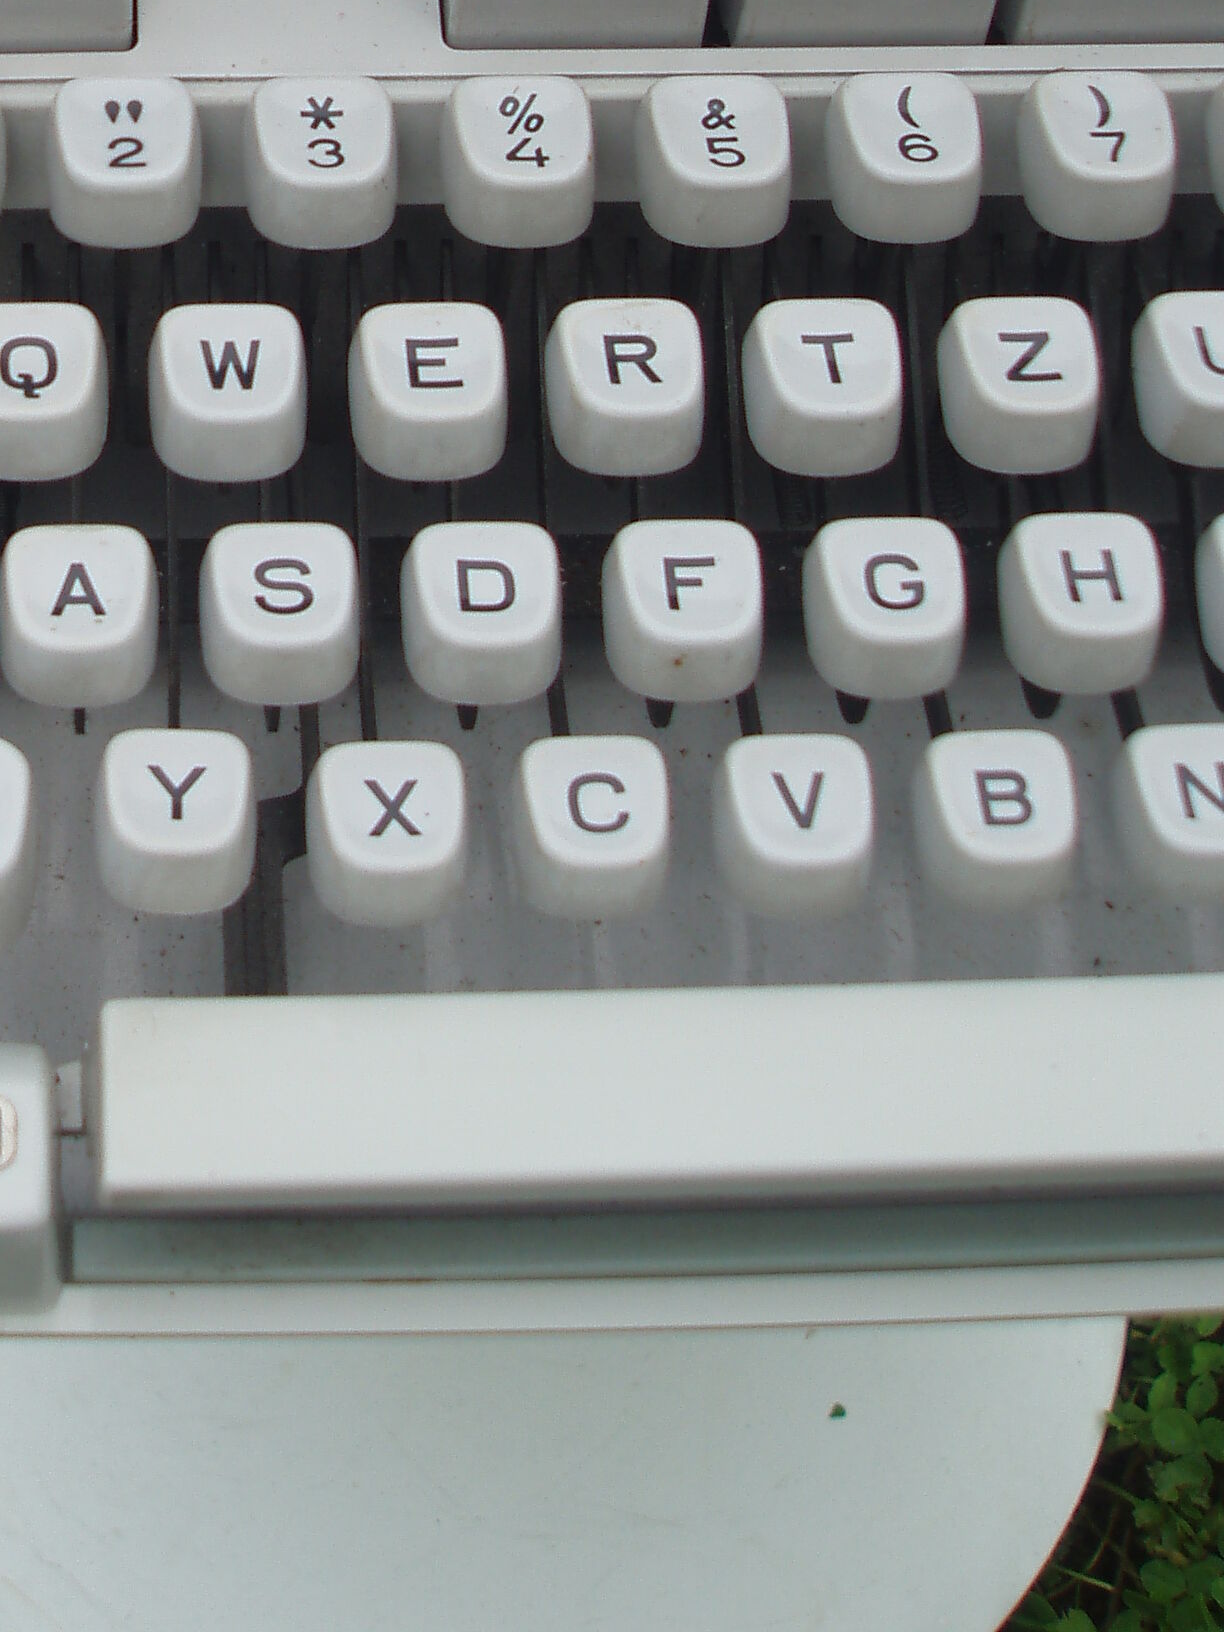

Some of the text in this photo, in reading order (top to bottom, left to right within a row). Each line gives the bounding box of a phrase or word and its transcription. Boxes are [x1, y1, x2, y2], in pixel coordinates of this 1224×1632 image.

[499, 93, 545, 135] %
[701, 98, 736, 130] &
[108, 137, 147, 168] 2
[307, 138, 345, 169] 3
[505, 137, 550, 168] 4
[706, 136, 746, 168] 5
[898, 133, 939, 163] 6
[1090, 131, 1126, 163] 7
[0, 337, 58, 399] Q
[200, 340, 260, 390] W
[405, 337, 464, 389] E
[603, 334, 663, 385] R
[801, 333, 854, 384] T
[998, 332, 1063, 382] Z
[50, 563, 106, 617] A
[254, 559, 314, 615] S
[457, 559, 516, 613] D
[663, 557, 715, 611] F
[864, 554, 925, 611] G
[1061, 549, 1124, 603] H
[147, 765, 207, 821] Y
[364, 779, 422, 837] X
[567, 773, 630, 834] C
[772, 772, 824, 830] V
[976, 770, 1033, 826] B
